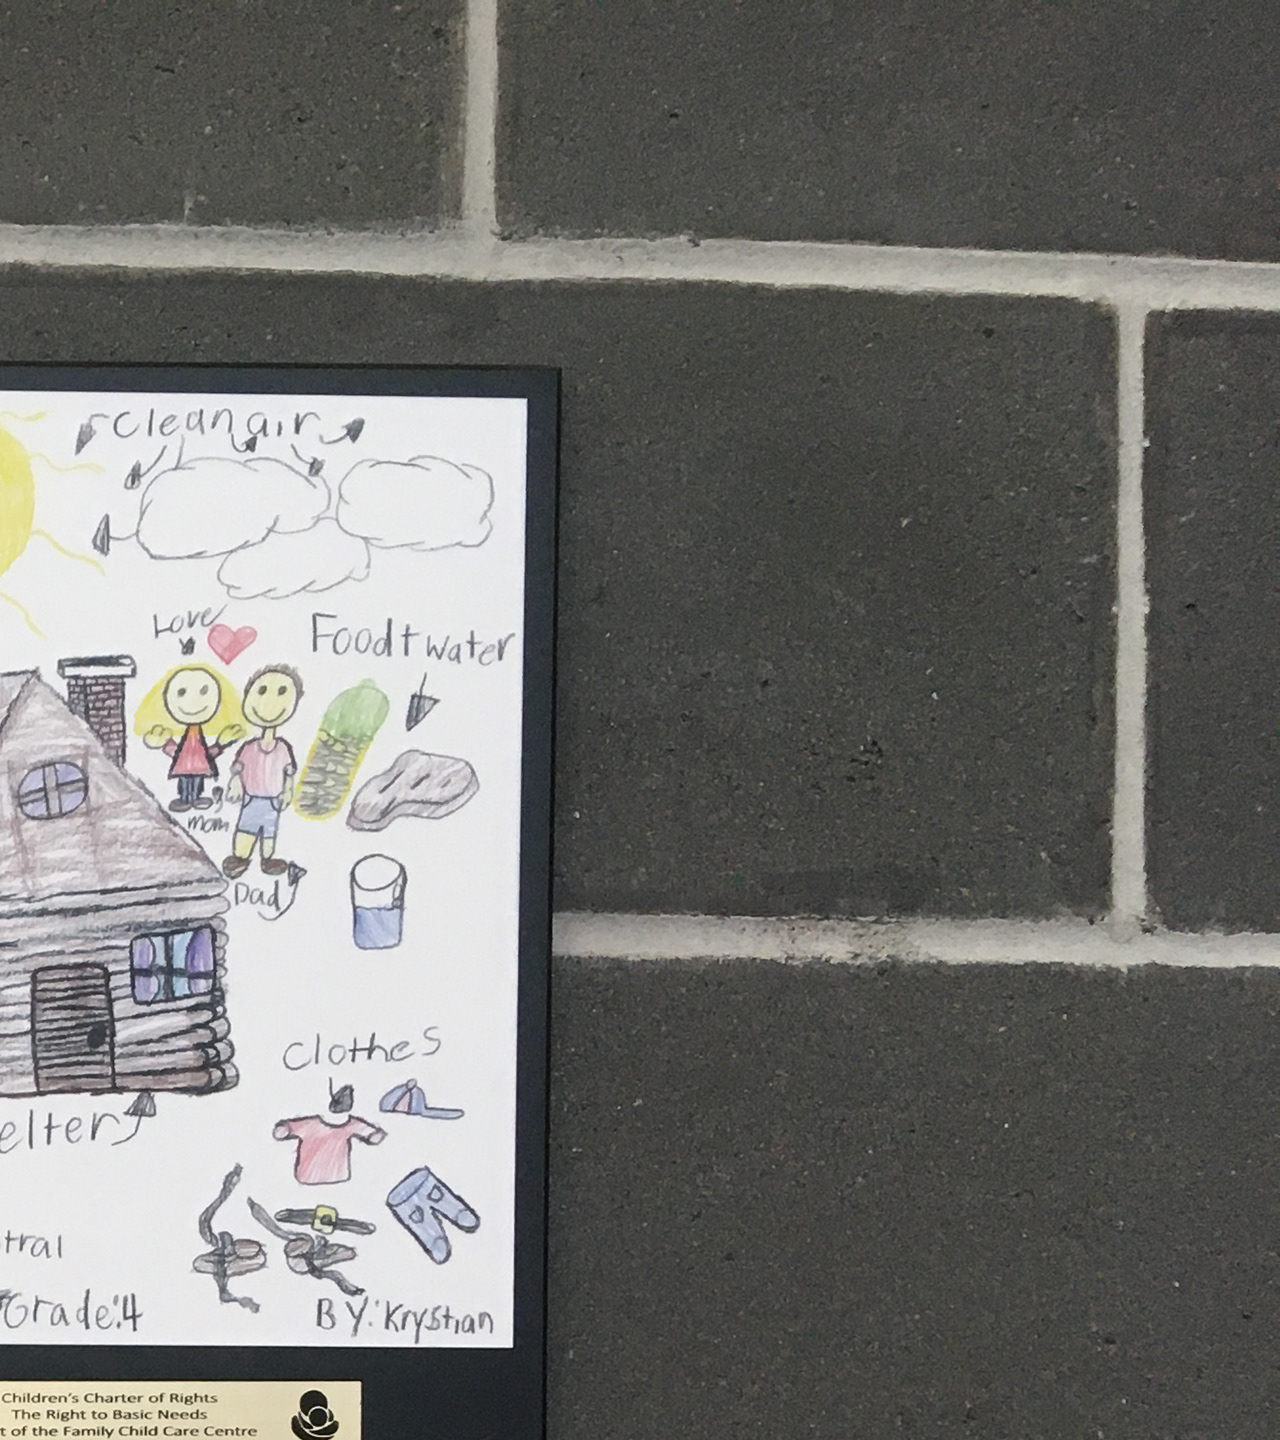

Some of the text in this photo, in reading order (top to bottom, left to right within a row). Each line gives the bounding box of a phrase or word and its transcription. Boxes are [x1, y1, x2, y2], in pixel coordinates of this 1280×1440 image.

[152, 604, 227, 638] Love
[235, 880, 281, 911] Dad
[1, 1392, 218, 1406] Children's Charter of Rights
[11, 1409, 208, 1422] The Right to Basic Needs
[11, 1425, 28, 1437] of
[32, 1425, 58, 1437] the
[63, 1426, 114, 1439] Family
[118, 1426, 158, 1437] Child
[163, 1426, 200, 1437] Care
[203, 1426, 258, 1437] Centre
